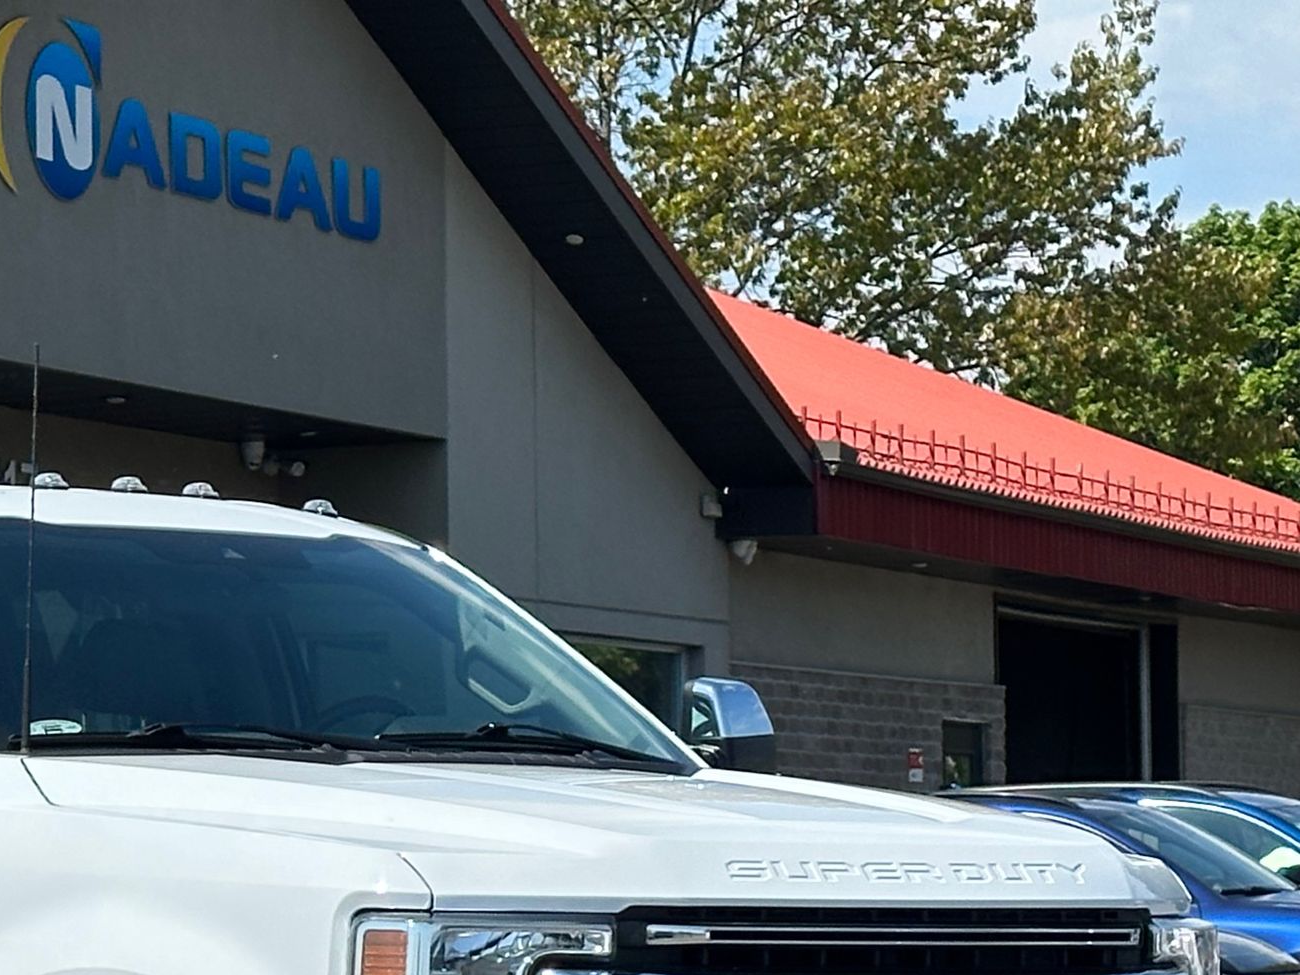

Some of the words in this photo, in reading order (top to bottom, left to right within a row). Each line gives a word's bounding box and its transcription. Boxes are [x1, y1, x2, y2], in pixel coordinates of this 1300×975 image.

[35, 73, 382, 243] NADEAU
[725, 859, 947, 885] SUPER
[948, 861, 1086, 886] DUTY
